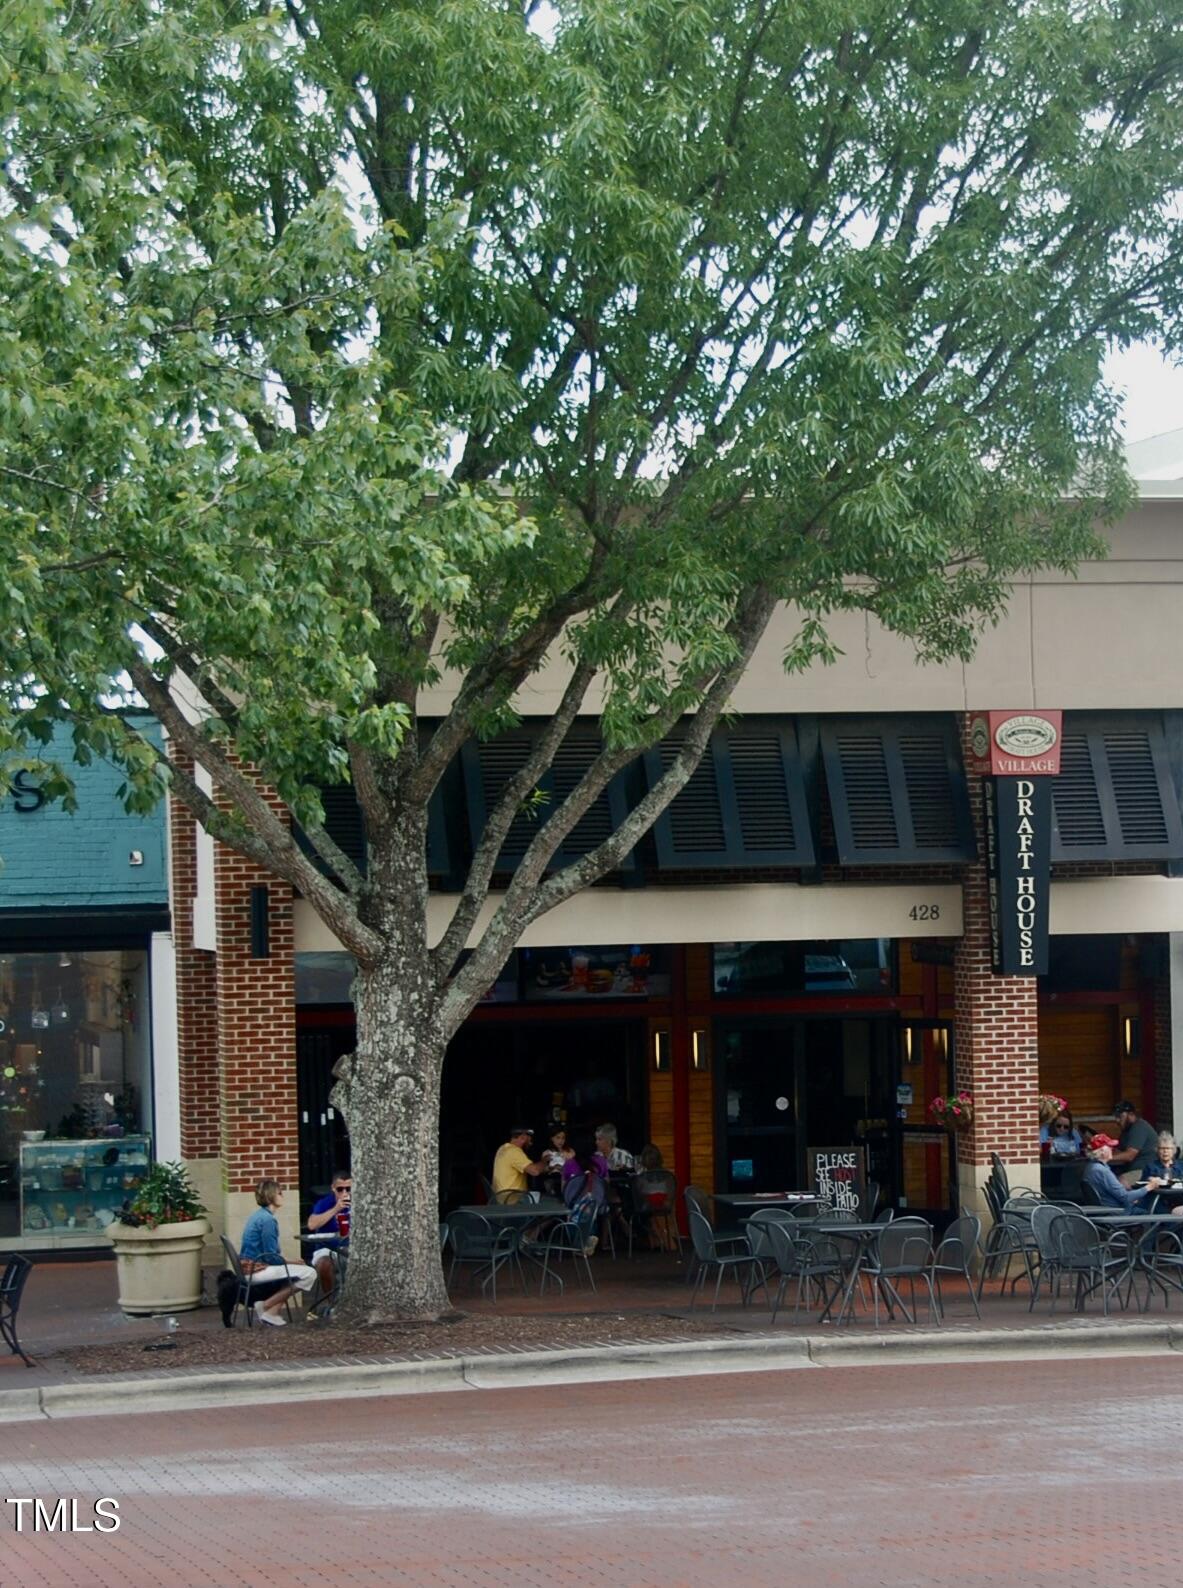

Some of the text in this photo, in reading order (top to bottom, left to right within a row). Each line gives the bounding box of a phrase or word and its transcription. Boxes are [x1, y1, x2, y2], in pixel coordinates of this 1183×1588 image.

[998, 760, 1055, 771] VILLAGE
[1016, 781, 1036, 966] DRAFT HOUSE
[909, 904, 940, 921] 428
[816, 1153, 856, 1169] PLEASE
[816, 1168, 830, 1182] SEE
[820, 1180, 852, 1195] INSIDE
[835, 1193, 859, 1210] PATIO
